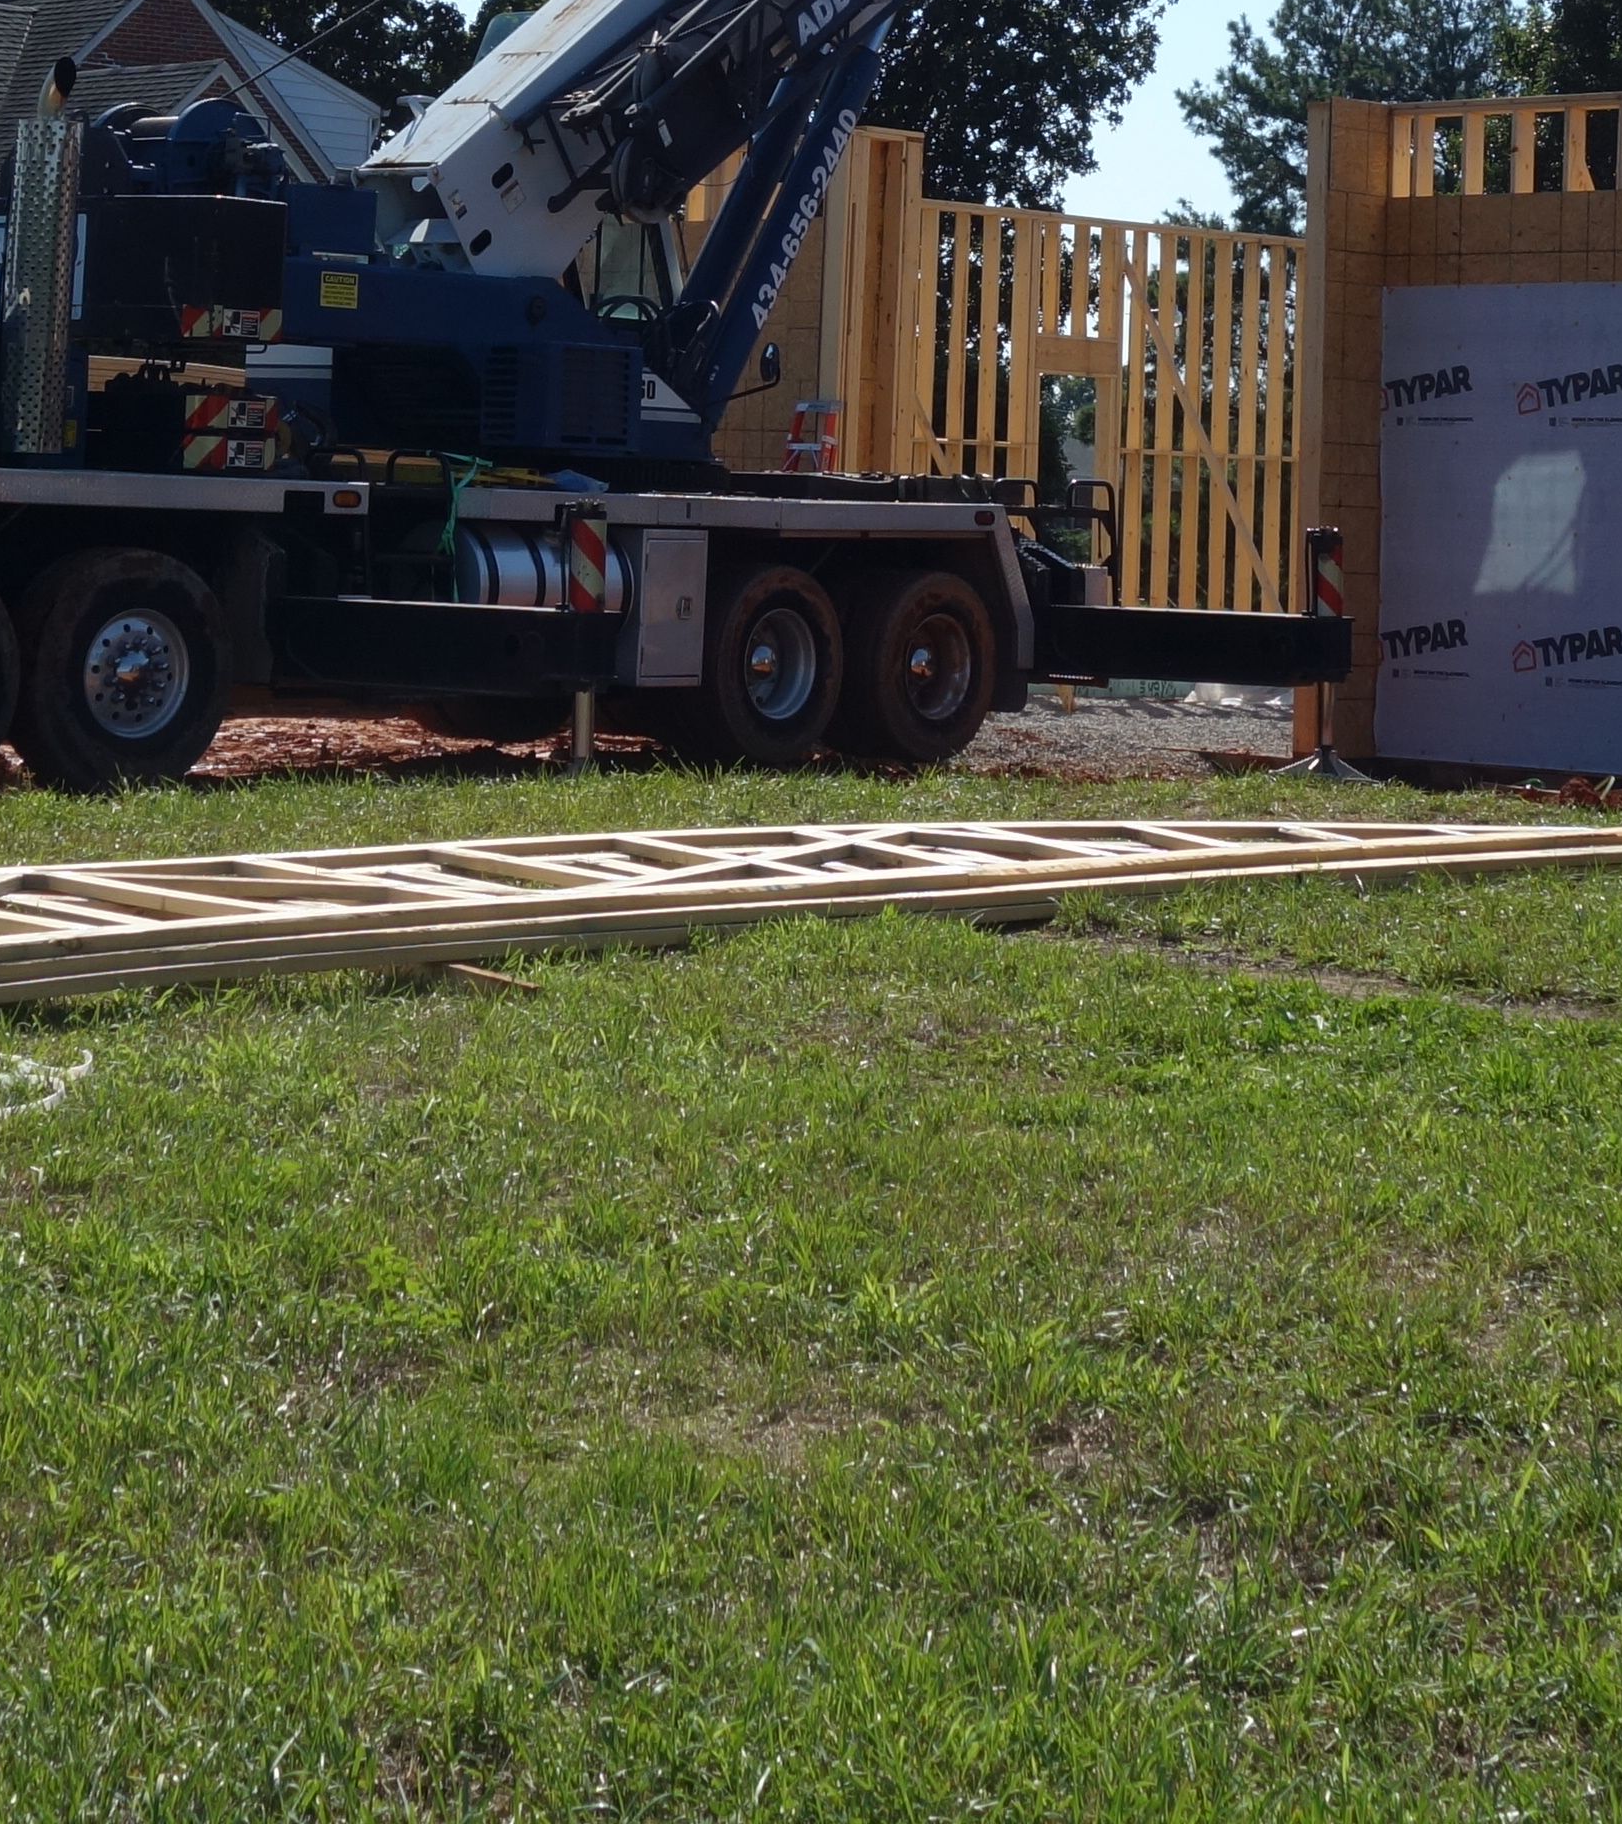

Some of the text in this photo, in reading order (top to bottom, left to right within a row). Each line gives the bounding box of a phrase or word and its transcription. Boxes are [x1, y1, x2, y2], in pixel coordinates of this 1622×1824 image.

[751, 108, 857, 330] 434-656-2440
[1384, 364, 1473, 408] TYPAR
[1380, 618, 1469, 659] TYPAR
